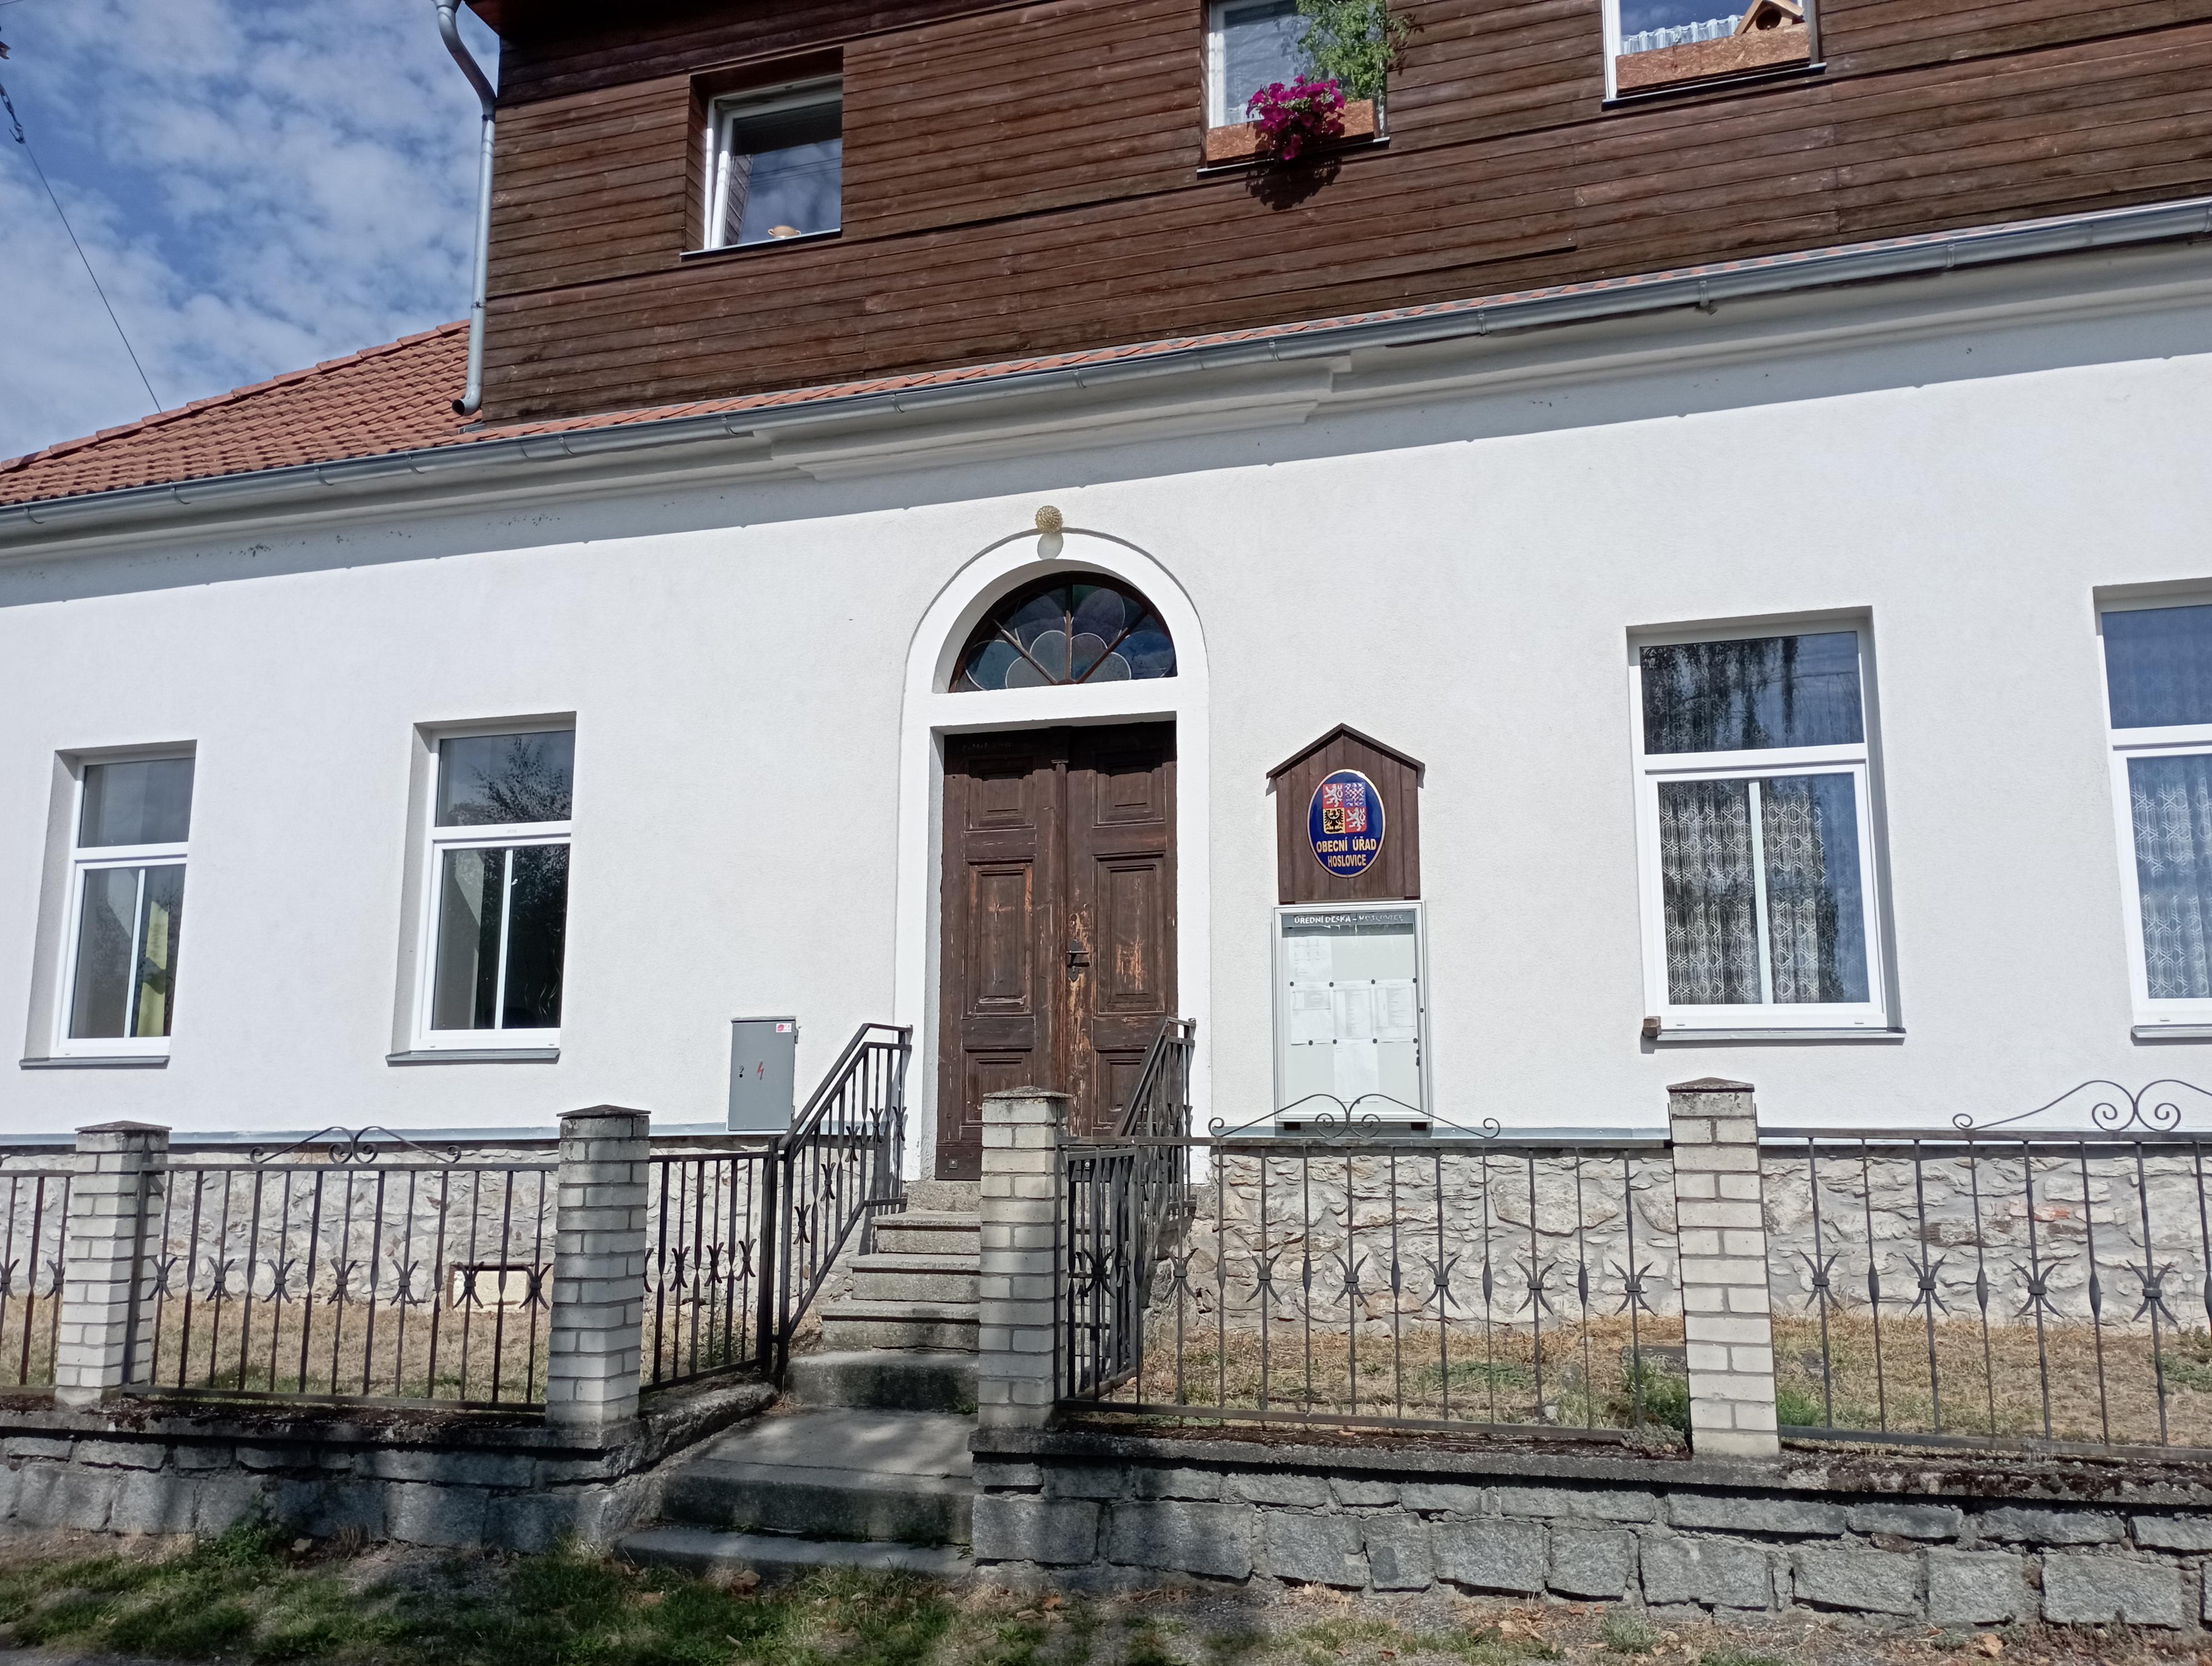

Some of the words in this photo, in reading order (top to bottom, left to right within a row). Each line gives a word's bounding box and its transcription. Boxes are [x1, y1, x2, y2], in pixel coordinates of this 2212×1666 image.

[1316, 836, 1348, 853] OBECNÍ
[1352, 836, 1377, 851] ÚŘAD
[1328, 854, 1367, 867] HOSLOVICE
